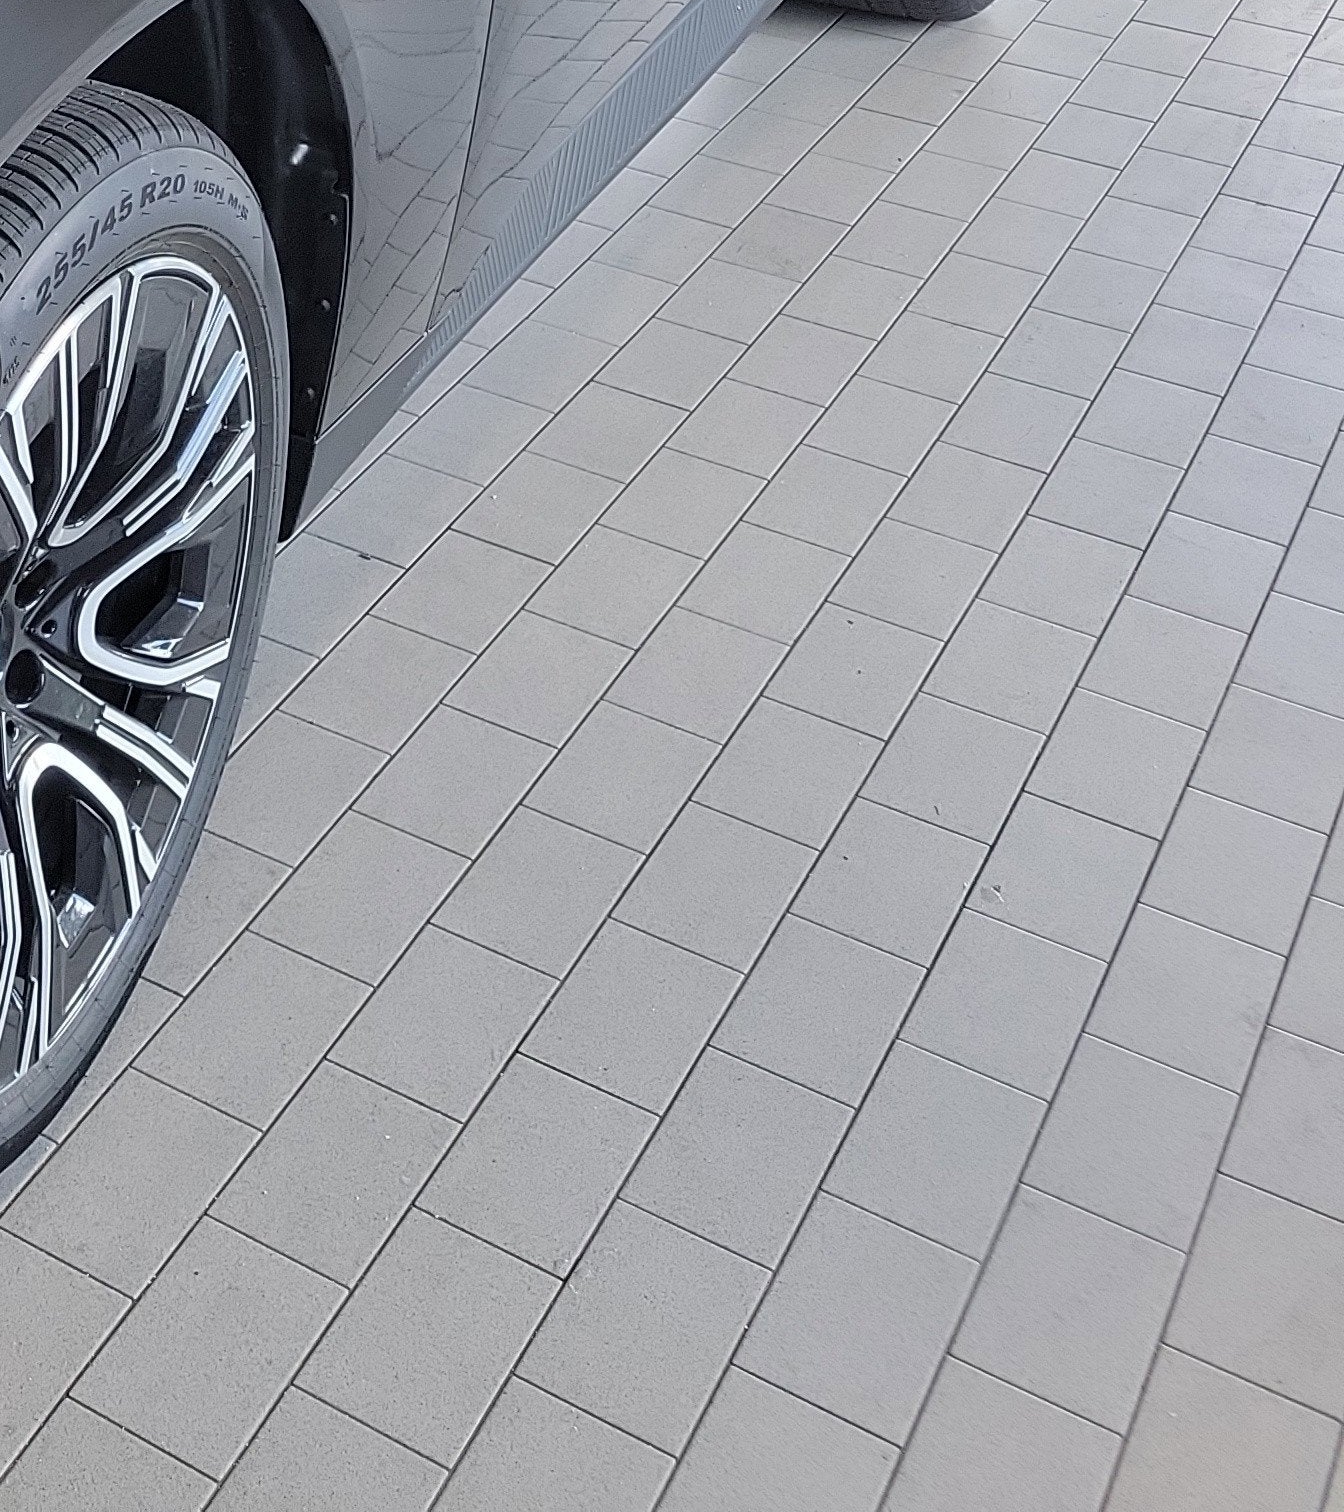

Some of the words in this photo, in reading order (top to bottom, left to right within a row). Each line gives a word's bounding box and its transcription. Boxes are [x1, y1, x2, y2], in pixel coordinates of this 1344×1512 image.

[35, 193, 133, 316] 255/45
[139, 173, 186, 208] R20
[193, 179, 225, 200] 105H
